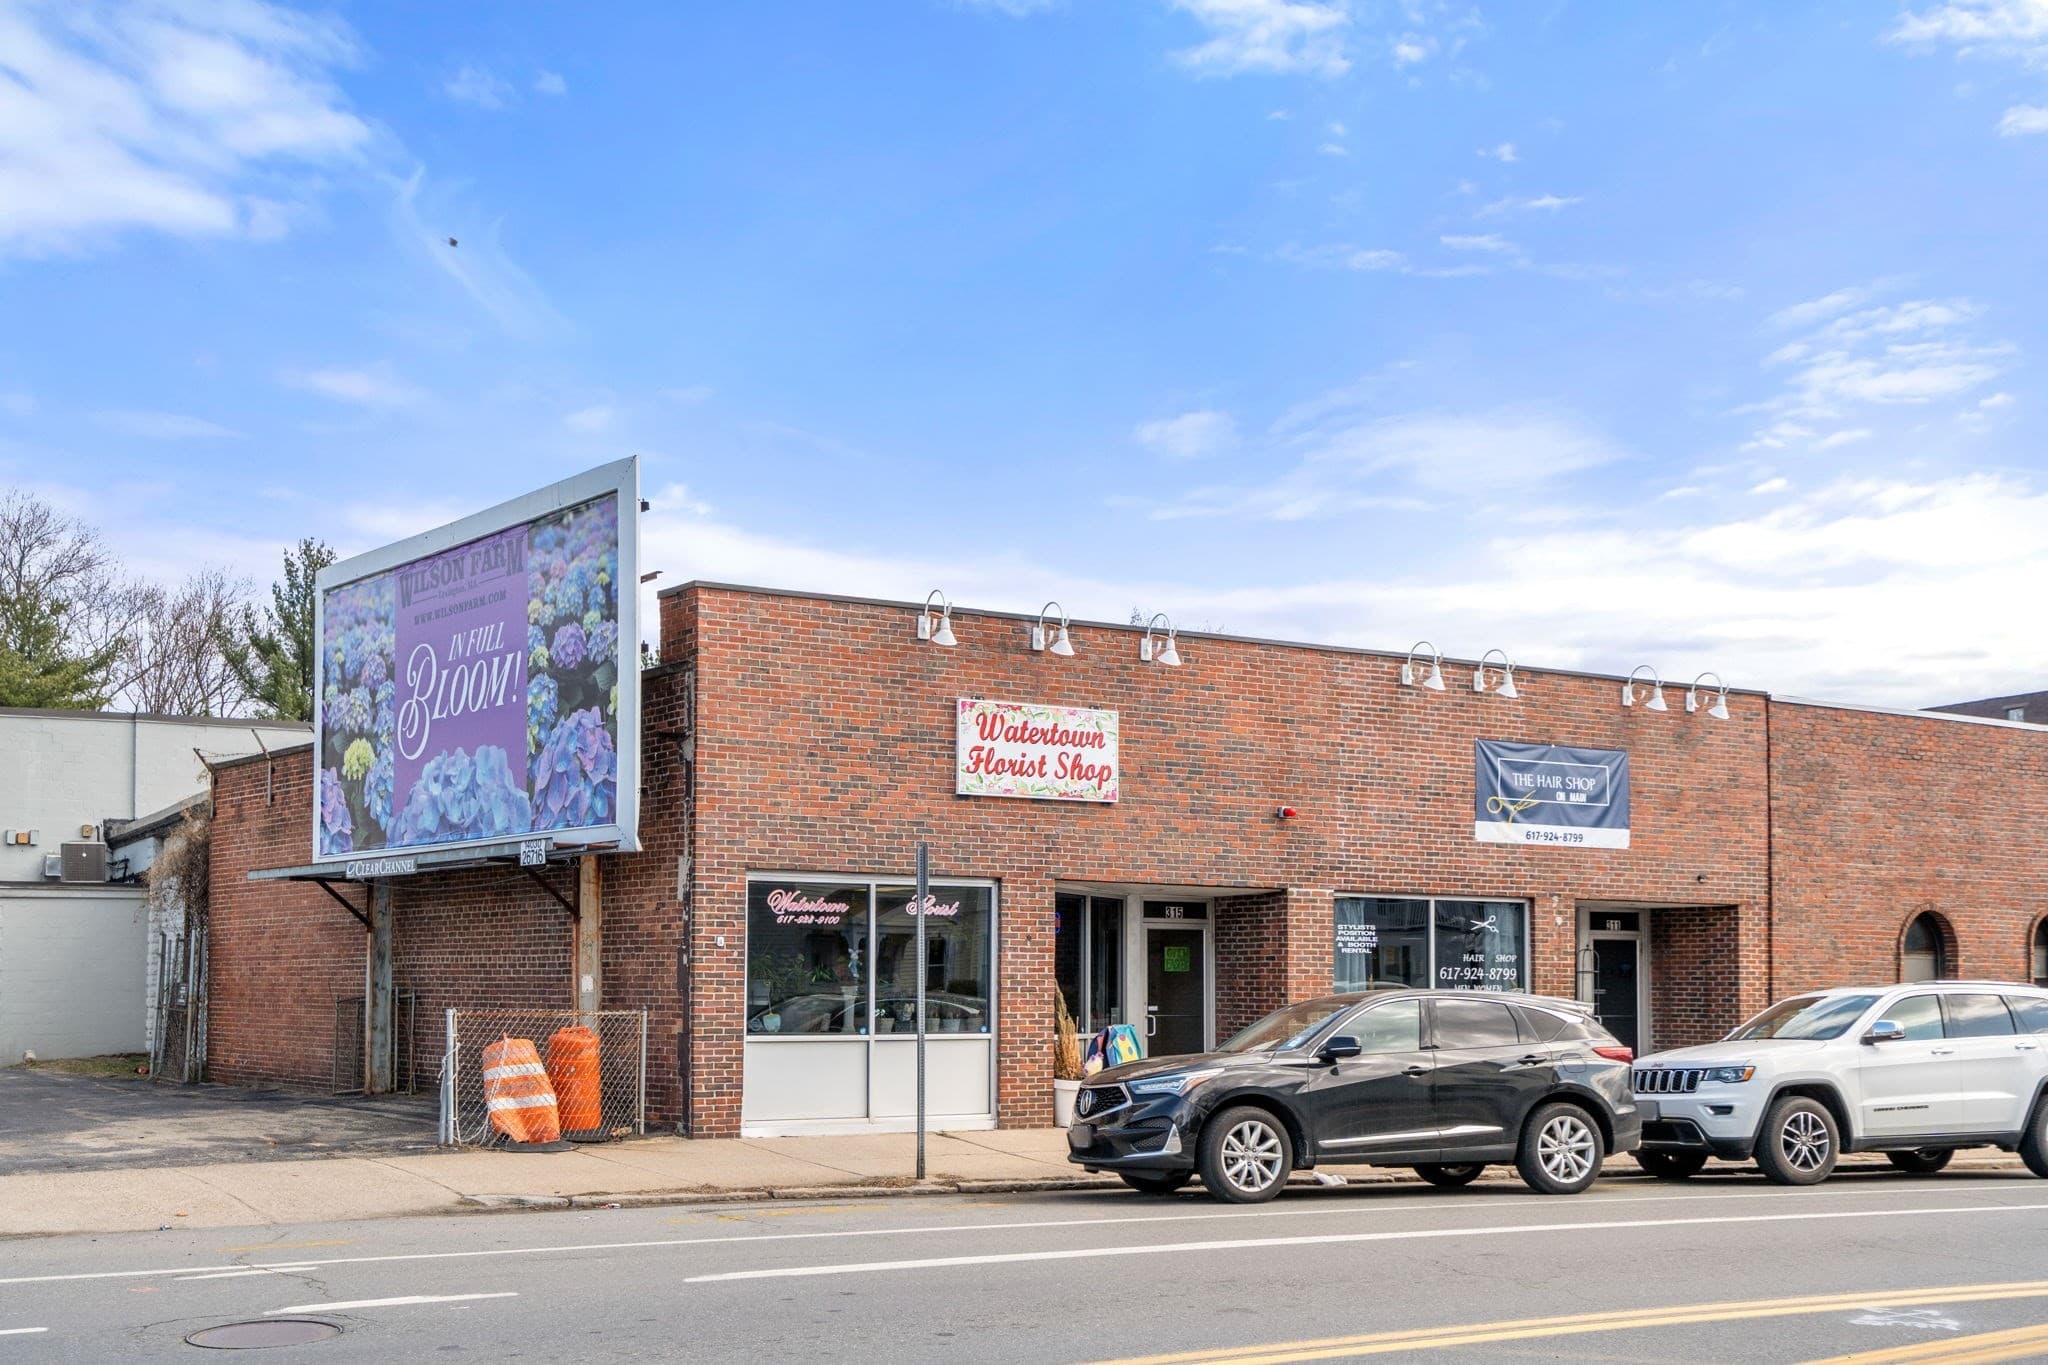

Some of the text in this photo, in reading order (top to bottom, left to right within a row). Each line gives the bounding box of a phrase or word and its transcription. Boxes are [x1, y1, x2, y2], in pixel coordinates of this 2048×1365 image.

[400, 537, 525, 608] WILSON FARM
[414, 590, 507, 625] WWW.WILSONFARM.COM
[448, 622, 505, 661] IN FULL
[397, 643, 521, 760] BLOOM!
[975, 712, 1106, 749] Watertown
[966, 745, 1112, 790] Florist Shop
[1512, 772, 1596, 791] THE HAIR SHOP
[1556, 791, 1587, 803] ON MAIN
[522, 848, 544, 865] 26716
[767, 889, 850, 914] Watertown
[1165, 906, 1184, 918] 315
[1462, 953, 1517, 963] HAIR SHOP
[1439, 967, 1518, 981] 617-924-8799
